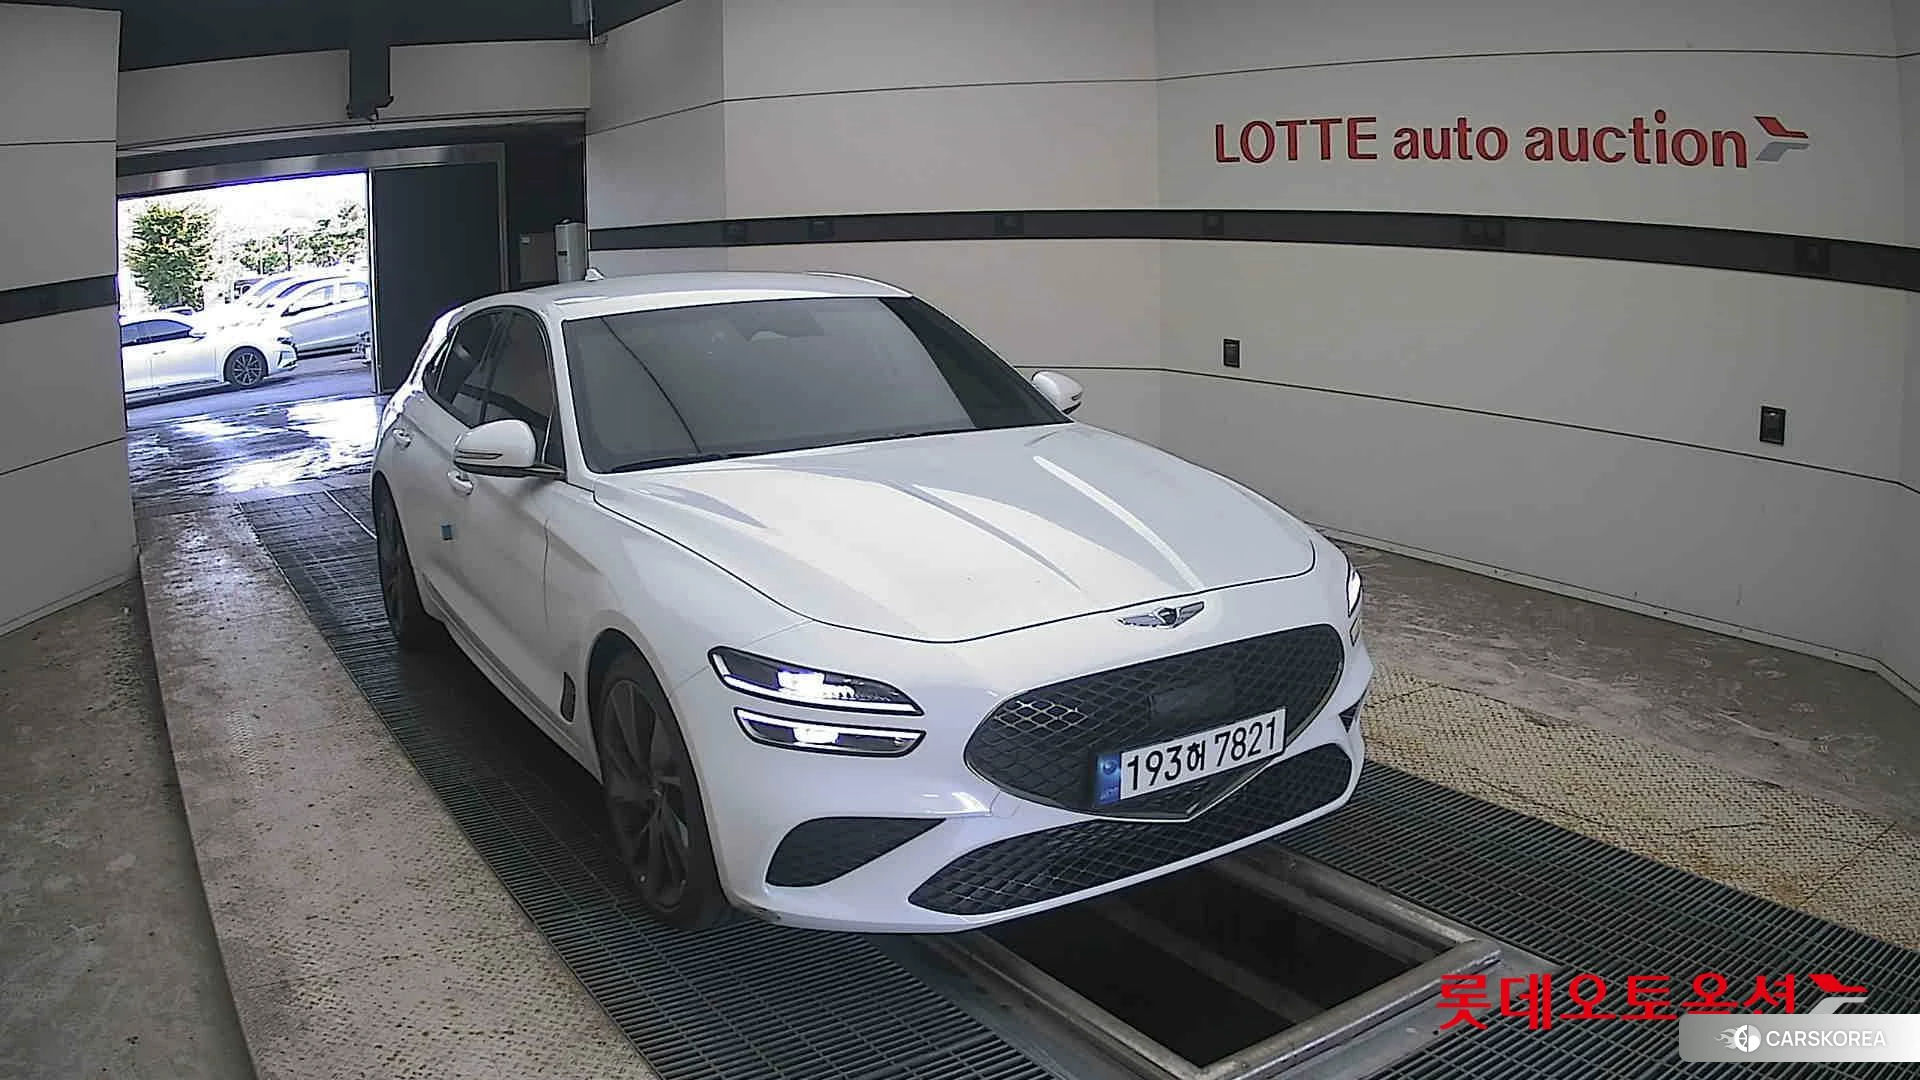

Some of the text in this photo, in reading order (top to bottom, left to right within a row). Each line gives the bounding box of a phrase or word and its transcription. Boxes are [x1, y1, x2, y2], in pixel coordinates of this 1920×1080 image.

[1215, 110, 1748, 168] LOTTE auto auction
[1127, 716, 1276, 791] 193허 7821
